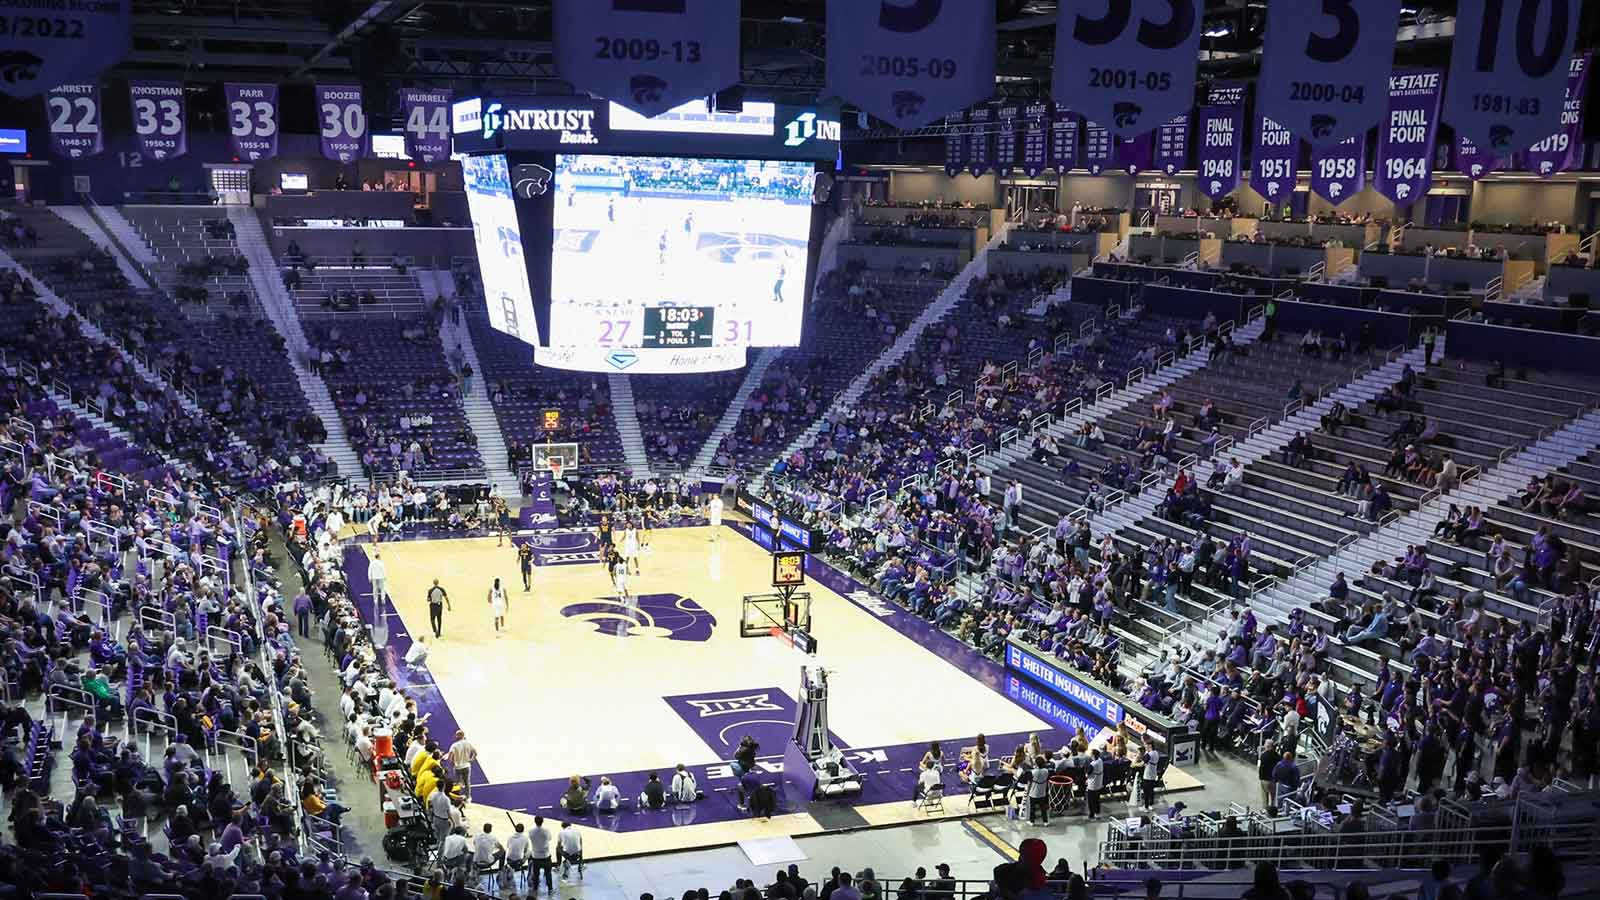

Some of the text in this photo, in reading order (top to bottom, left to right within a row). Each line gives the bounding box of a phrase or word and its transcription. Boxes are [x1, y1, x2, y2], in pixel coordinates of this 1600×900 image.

[595, 37, 701, 62] 2009-13
[860, 56, 956, 79] 2005-09
[1088, 68, 1171, 90] 2001-05
[1389, 74, 1439, 90] K-STATE
[131, 87, 183, 96] KNOSTMAN
[239, 89, 264, 98] PARR
[323, 91, 360, 100] BOOZER
[407, 94, 448, 102] MURRELL
[1290, 81, 1365, 104] 2000-04
[50, 97, 98, 133] 22
[136, 99, 182, 135] 33
[231, 101, 276, 137] 33
[321, 103, 365, 138] 30
[407, 106, 449, 140] 44
[503, 109, 594, 130] INTRUST
[1391, 109, 1427, 126] FINAL
[1207, 118, 1234, 132] FINAL
[1389, 126, 1425, 143] FOUR
[60, 139, 92, 147] 1948-51
[1206, 132, 1232, 146] FOUR
[1261, 131, 1290, 146] FOUR
[120, 152, 143, 168] 12
[1203, 159, 1233, 178] 1948
[1260, 159, 1291, 178] 1951
[1318, 159, 1356, 178] 1958
[1385, 158, 1426, 179] 1964
[659, 309, 699, 322] 18:03
[599, 320, 632, 342] 27
[723, 319, 753, 342] 31
[1022, 656, 1104, 710] SHELTER INSURANCE
